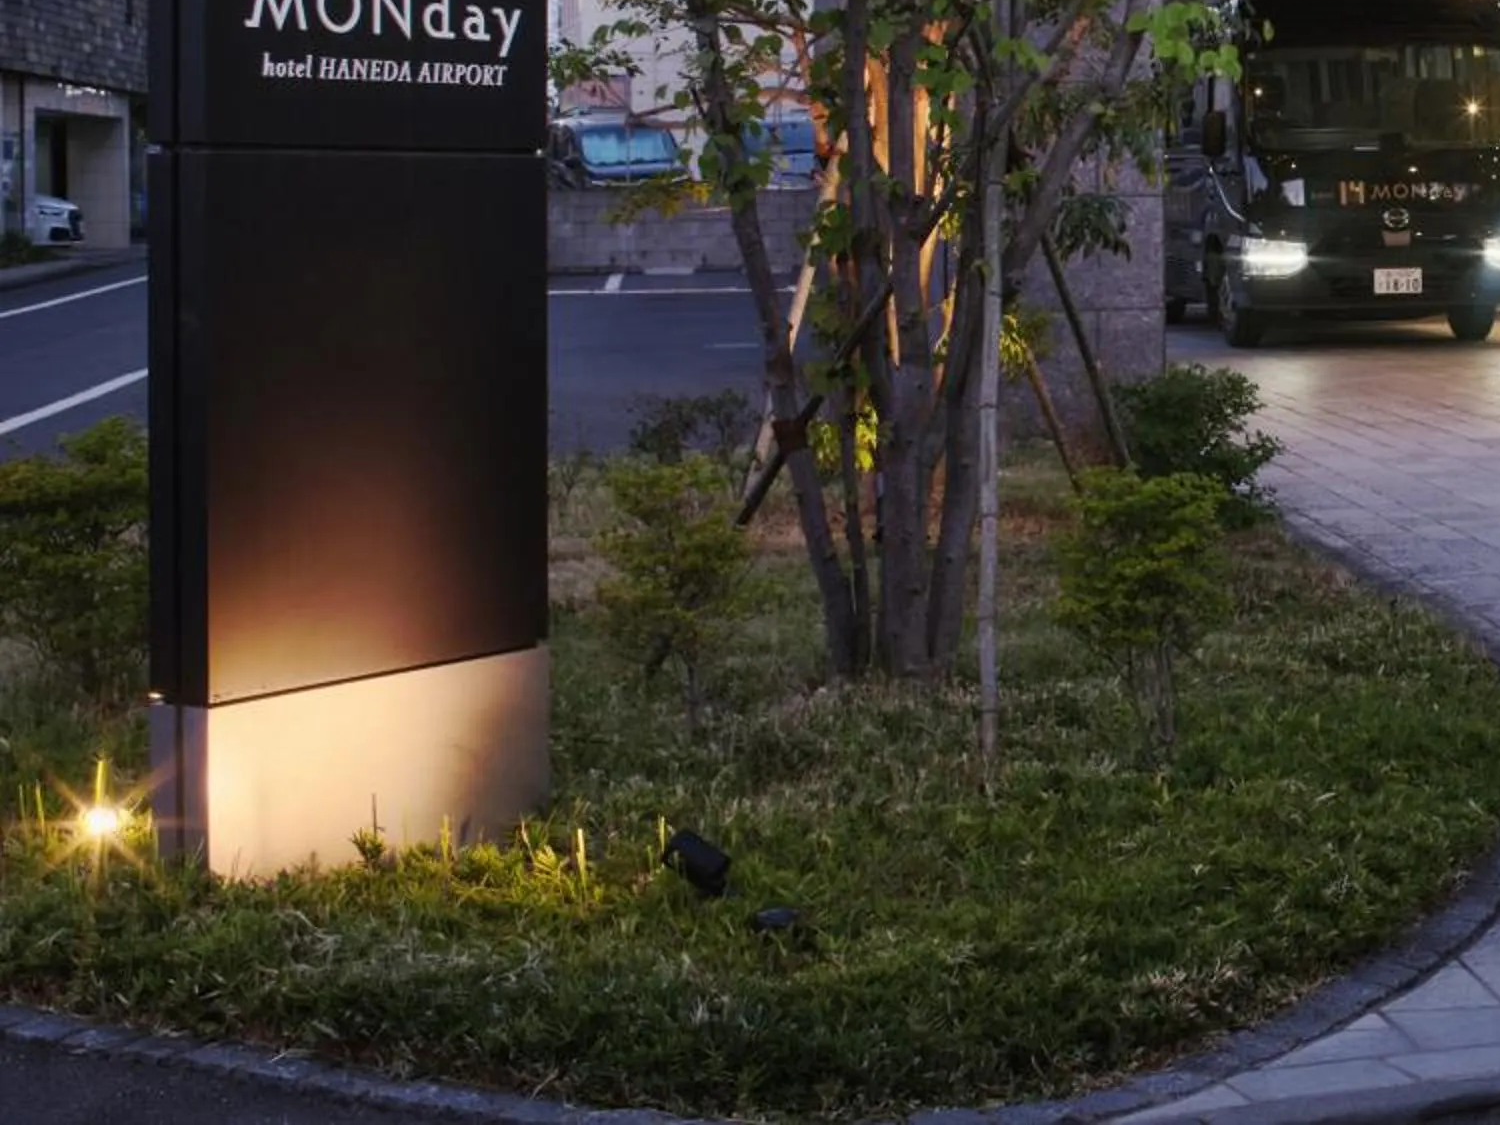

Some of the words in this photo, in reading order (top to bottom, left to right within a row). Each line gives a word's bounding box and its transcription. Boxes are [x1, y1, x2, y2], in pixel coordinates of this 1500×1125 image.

[262, 51, 313, 79] hotel
[318, 56, 411, 83] HANEDA
[417, 62, 508, 87] AIRPORT
